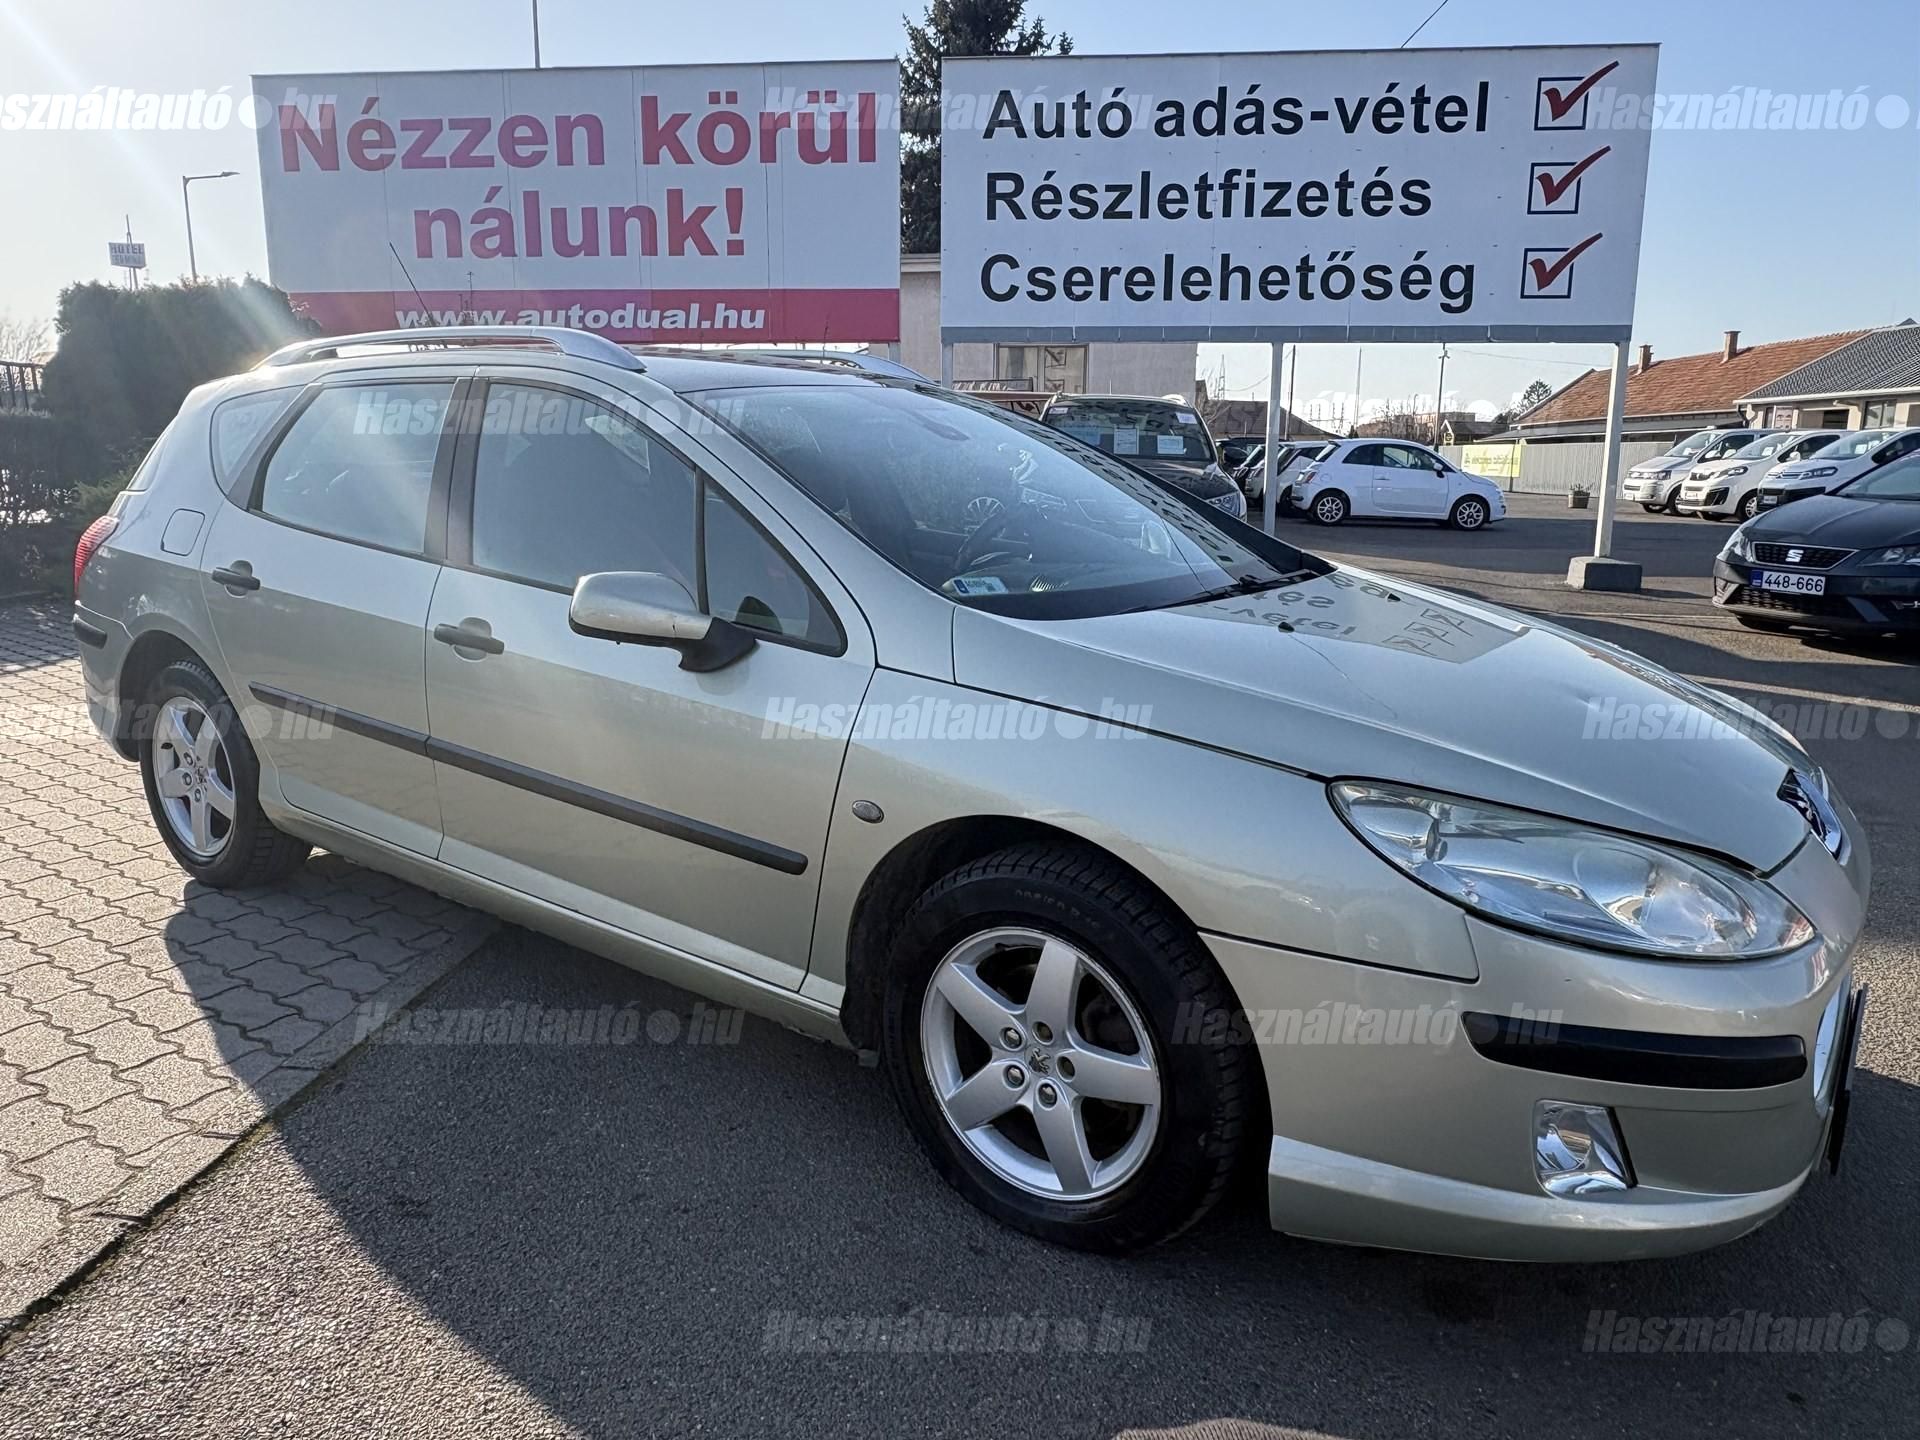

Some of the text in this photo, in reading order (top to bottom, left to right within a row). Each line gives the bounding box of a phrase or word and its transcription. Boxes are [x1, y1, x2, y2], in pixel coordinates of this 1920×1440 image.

[278, 90, 877, 172] Nézzen körül
[983, 81, 1490, 140] Autó adás-vétel
[414, 186, 744, 259] nálunk!
[986, 166, 1432, 221] Részletfizetés
[981, 250, 1475, 314] Cserelehetőség
[395, 303, 765, 329] www.autodual.hu
[1764, 574, 1824, 592] 448-666
